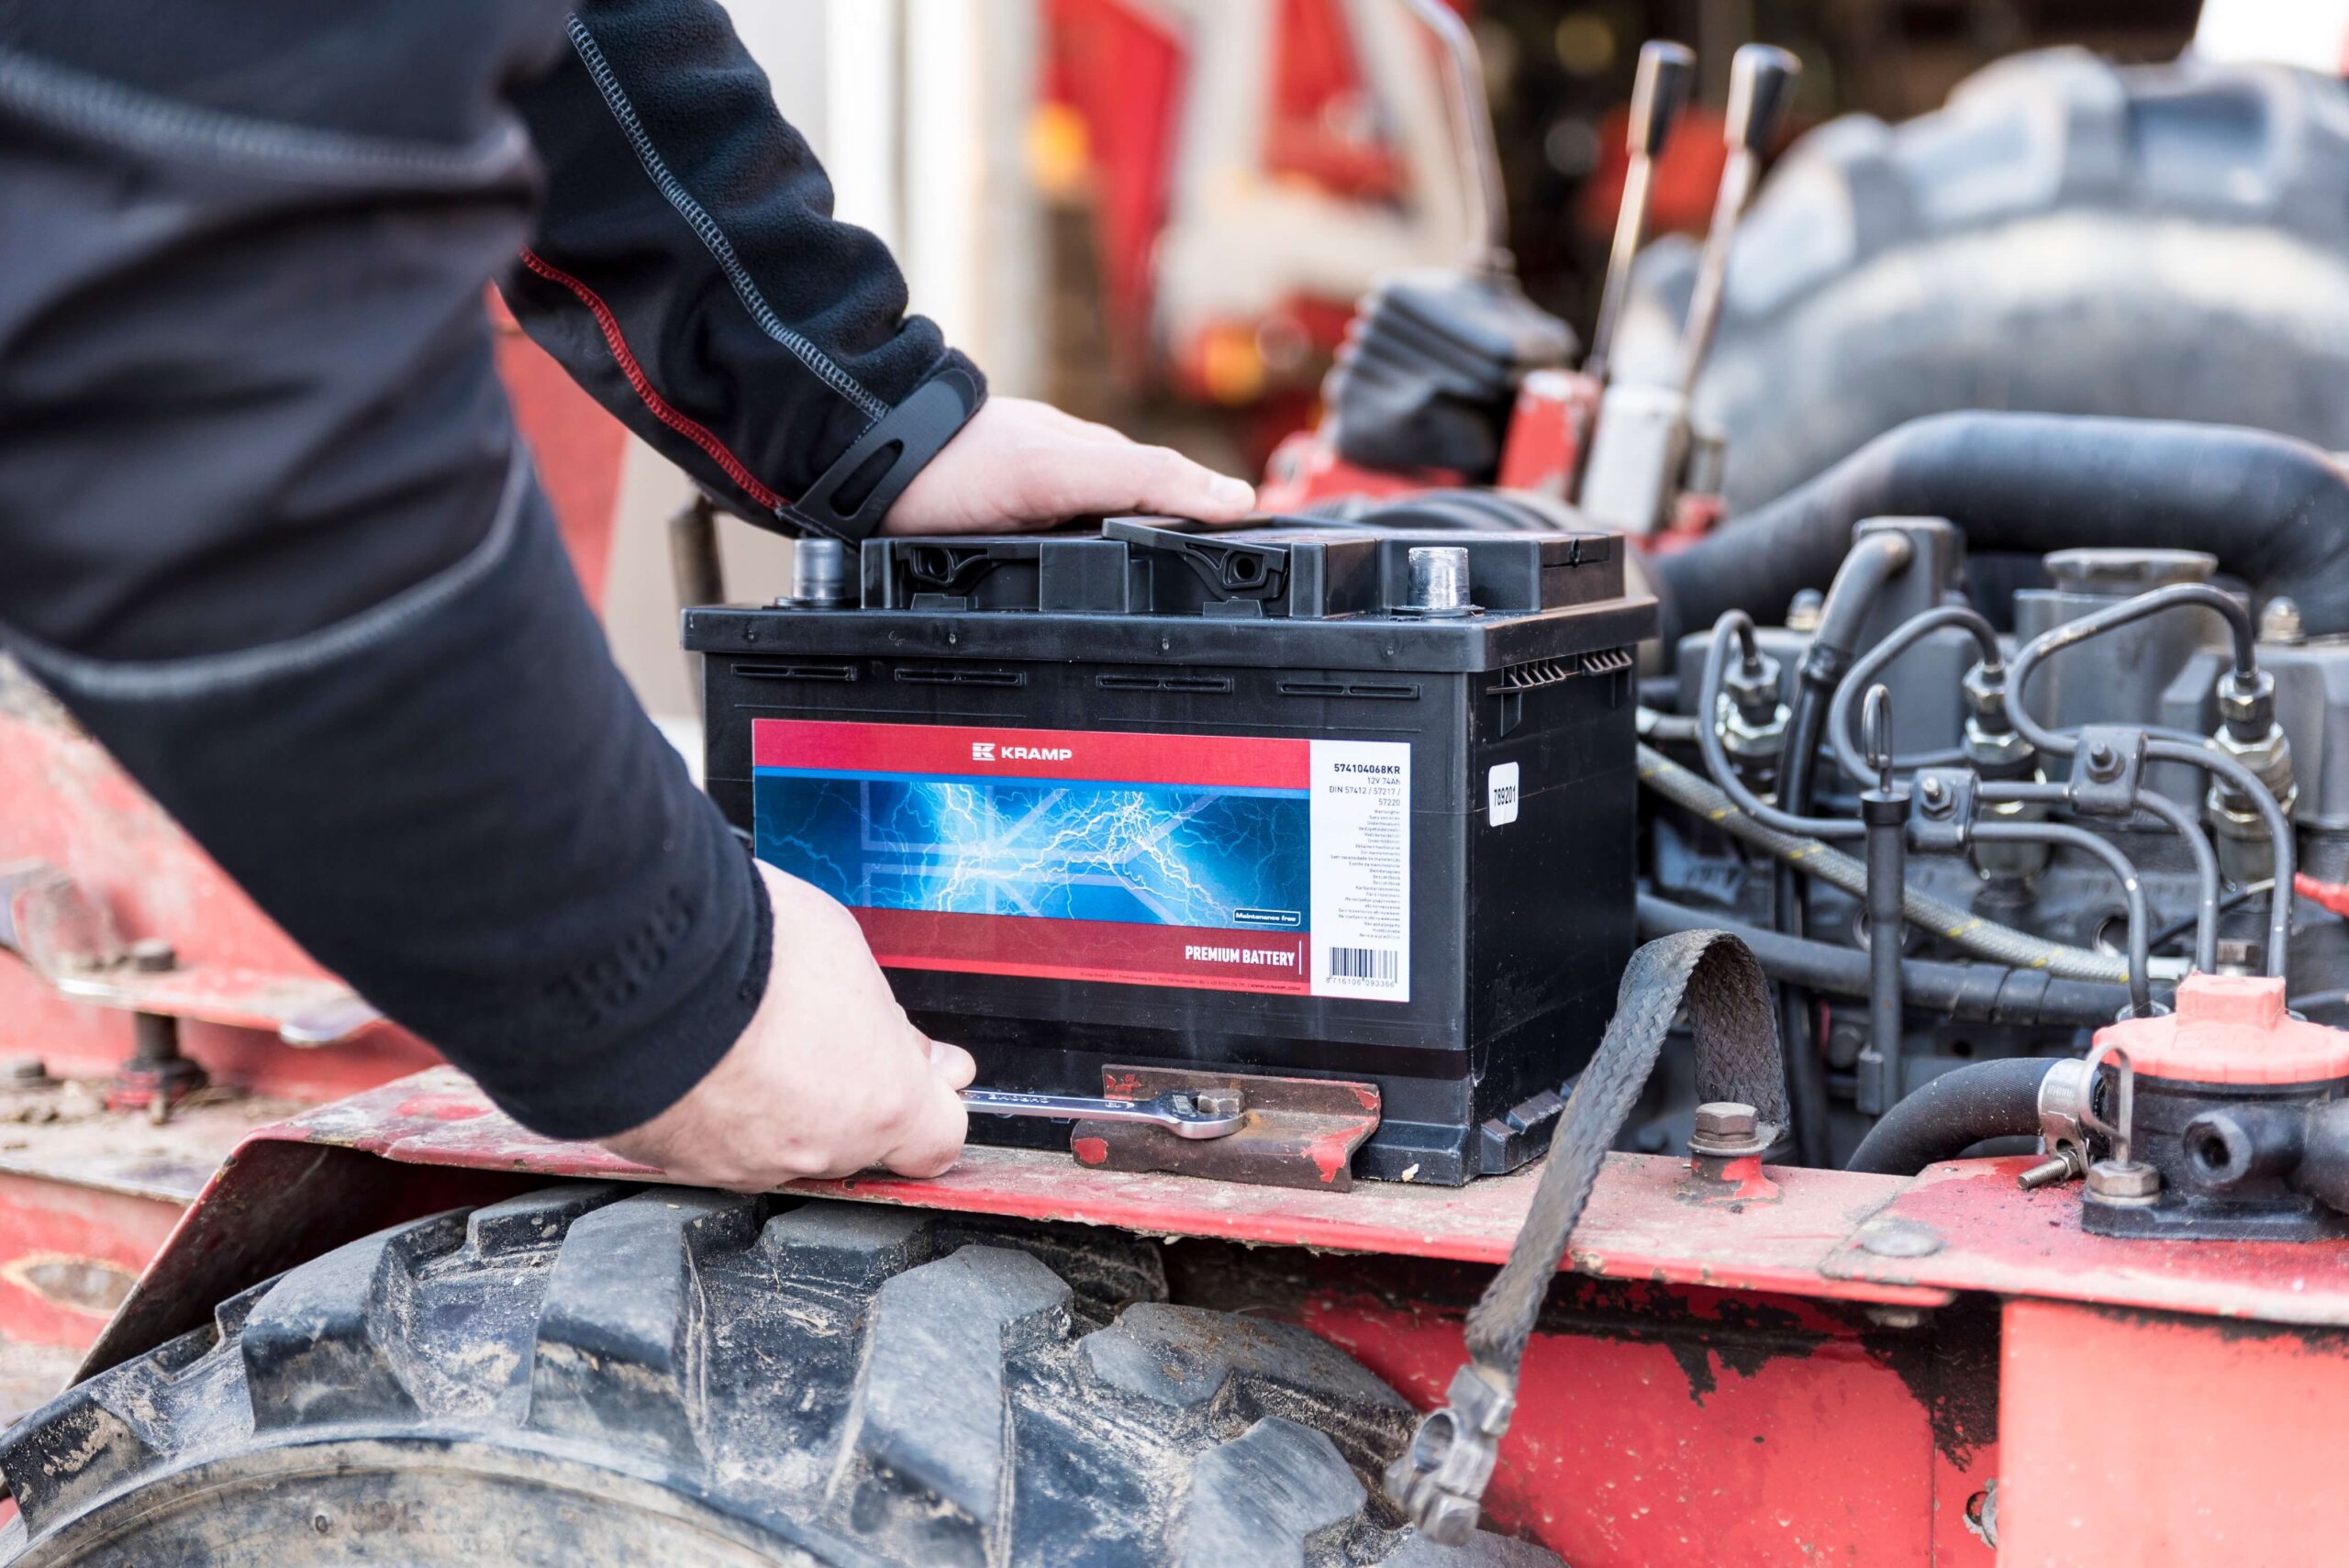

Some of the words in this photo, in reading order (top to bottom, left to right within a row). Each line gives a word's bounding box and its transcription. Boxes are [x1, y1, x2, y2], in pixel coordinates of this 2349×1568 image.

[1001, 746, 1072, 761] KRAMP
[1334, 763, 1400, 774] 574104068KR
[1383, 777, 1400, 785] 74Ah
[1345, 786, 1366, 795] 57412
[1374, 787, 1395, 795] 57217
[1494, 785, 1516, 806] 789201
[1378, 798, 1400, 806] 57220
[1235, 912, 1279, 921] Maintenance
[1186, 945, 1240, 963] PREMIUM
[1242, 949, 1295, 966] BATTERY
